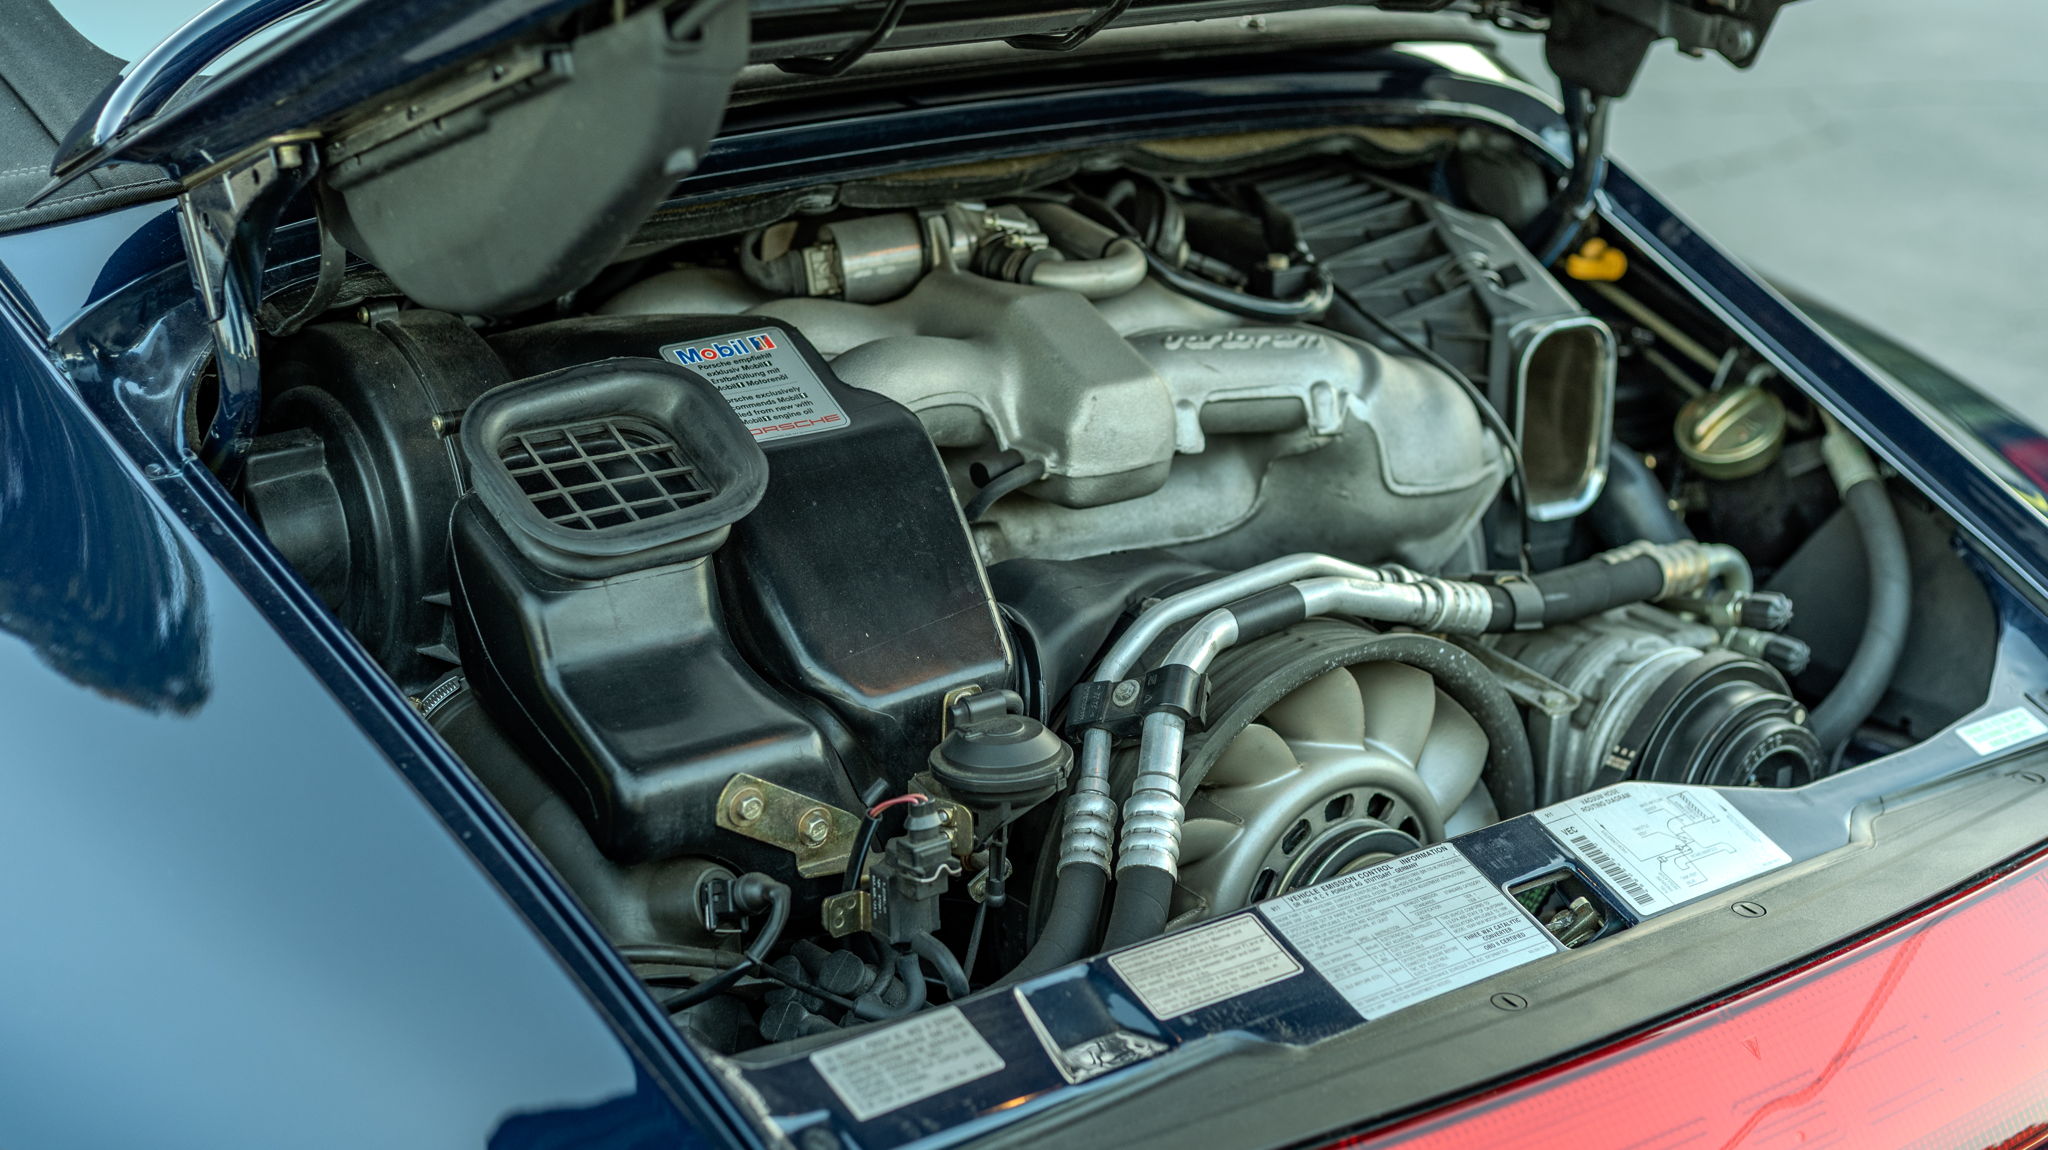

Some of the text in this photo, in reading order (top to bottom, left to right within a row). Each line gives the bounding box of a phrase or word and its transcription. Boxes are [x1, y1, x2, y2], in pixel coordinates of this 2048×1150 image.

[674, 339, 750, 365] Mobil
[697, 352, 772, 370] Porsche empfiehlt
[706, 367, 740, 377] exklusiv
[711, 371, 766, 384] Erstbefüllung
[746, 374, 788, 387] Motorenöl
[727, 386, 801, 403] orsche exclusively
[753, 408, 774, 416] from
[775, 404, 794, 412] new
[795, 400, 814, 408] with
[772, 411, 802, 420] engine
[748, 413, 841, 436] ORSCHE
[1561, 826, 1578, 836] VEC
[1287, 846, 1448, 902] VEHICLE EMISSION CONTROL INFORMATION
[1330, 884, 1355, 895] PORSCHE
[1364, 871, 1392, 884] STUTTGART
[1395, 862, 1418, 873] GERMANY
[1464, 932, 1482, 940] THREE
[1493, 918, 1521, 930] CATALYTIC
[1482, 927, 1513, 941] CONVERTER
[1500, 932, 1526, 944] CERTIFIED
